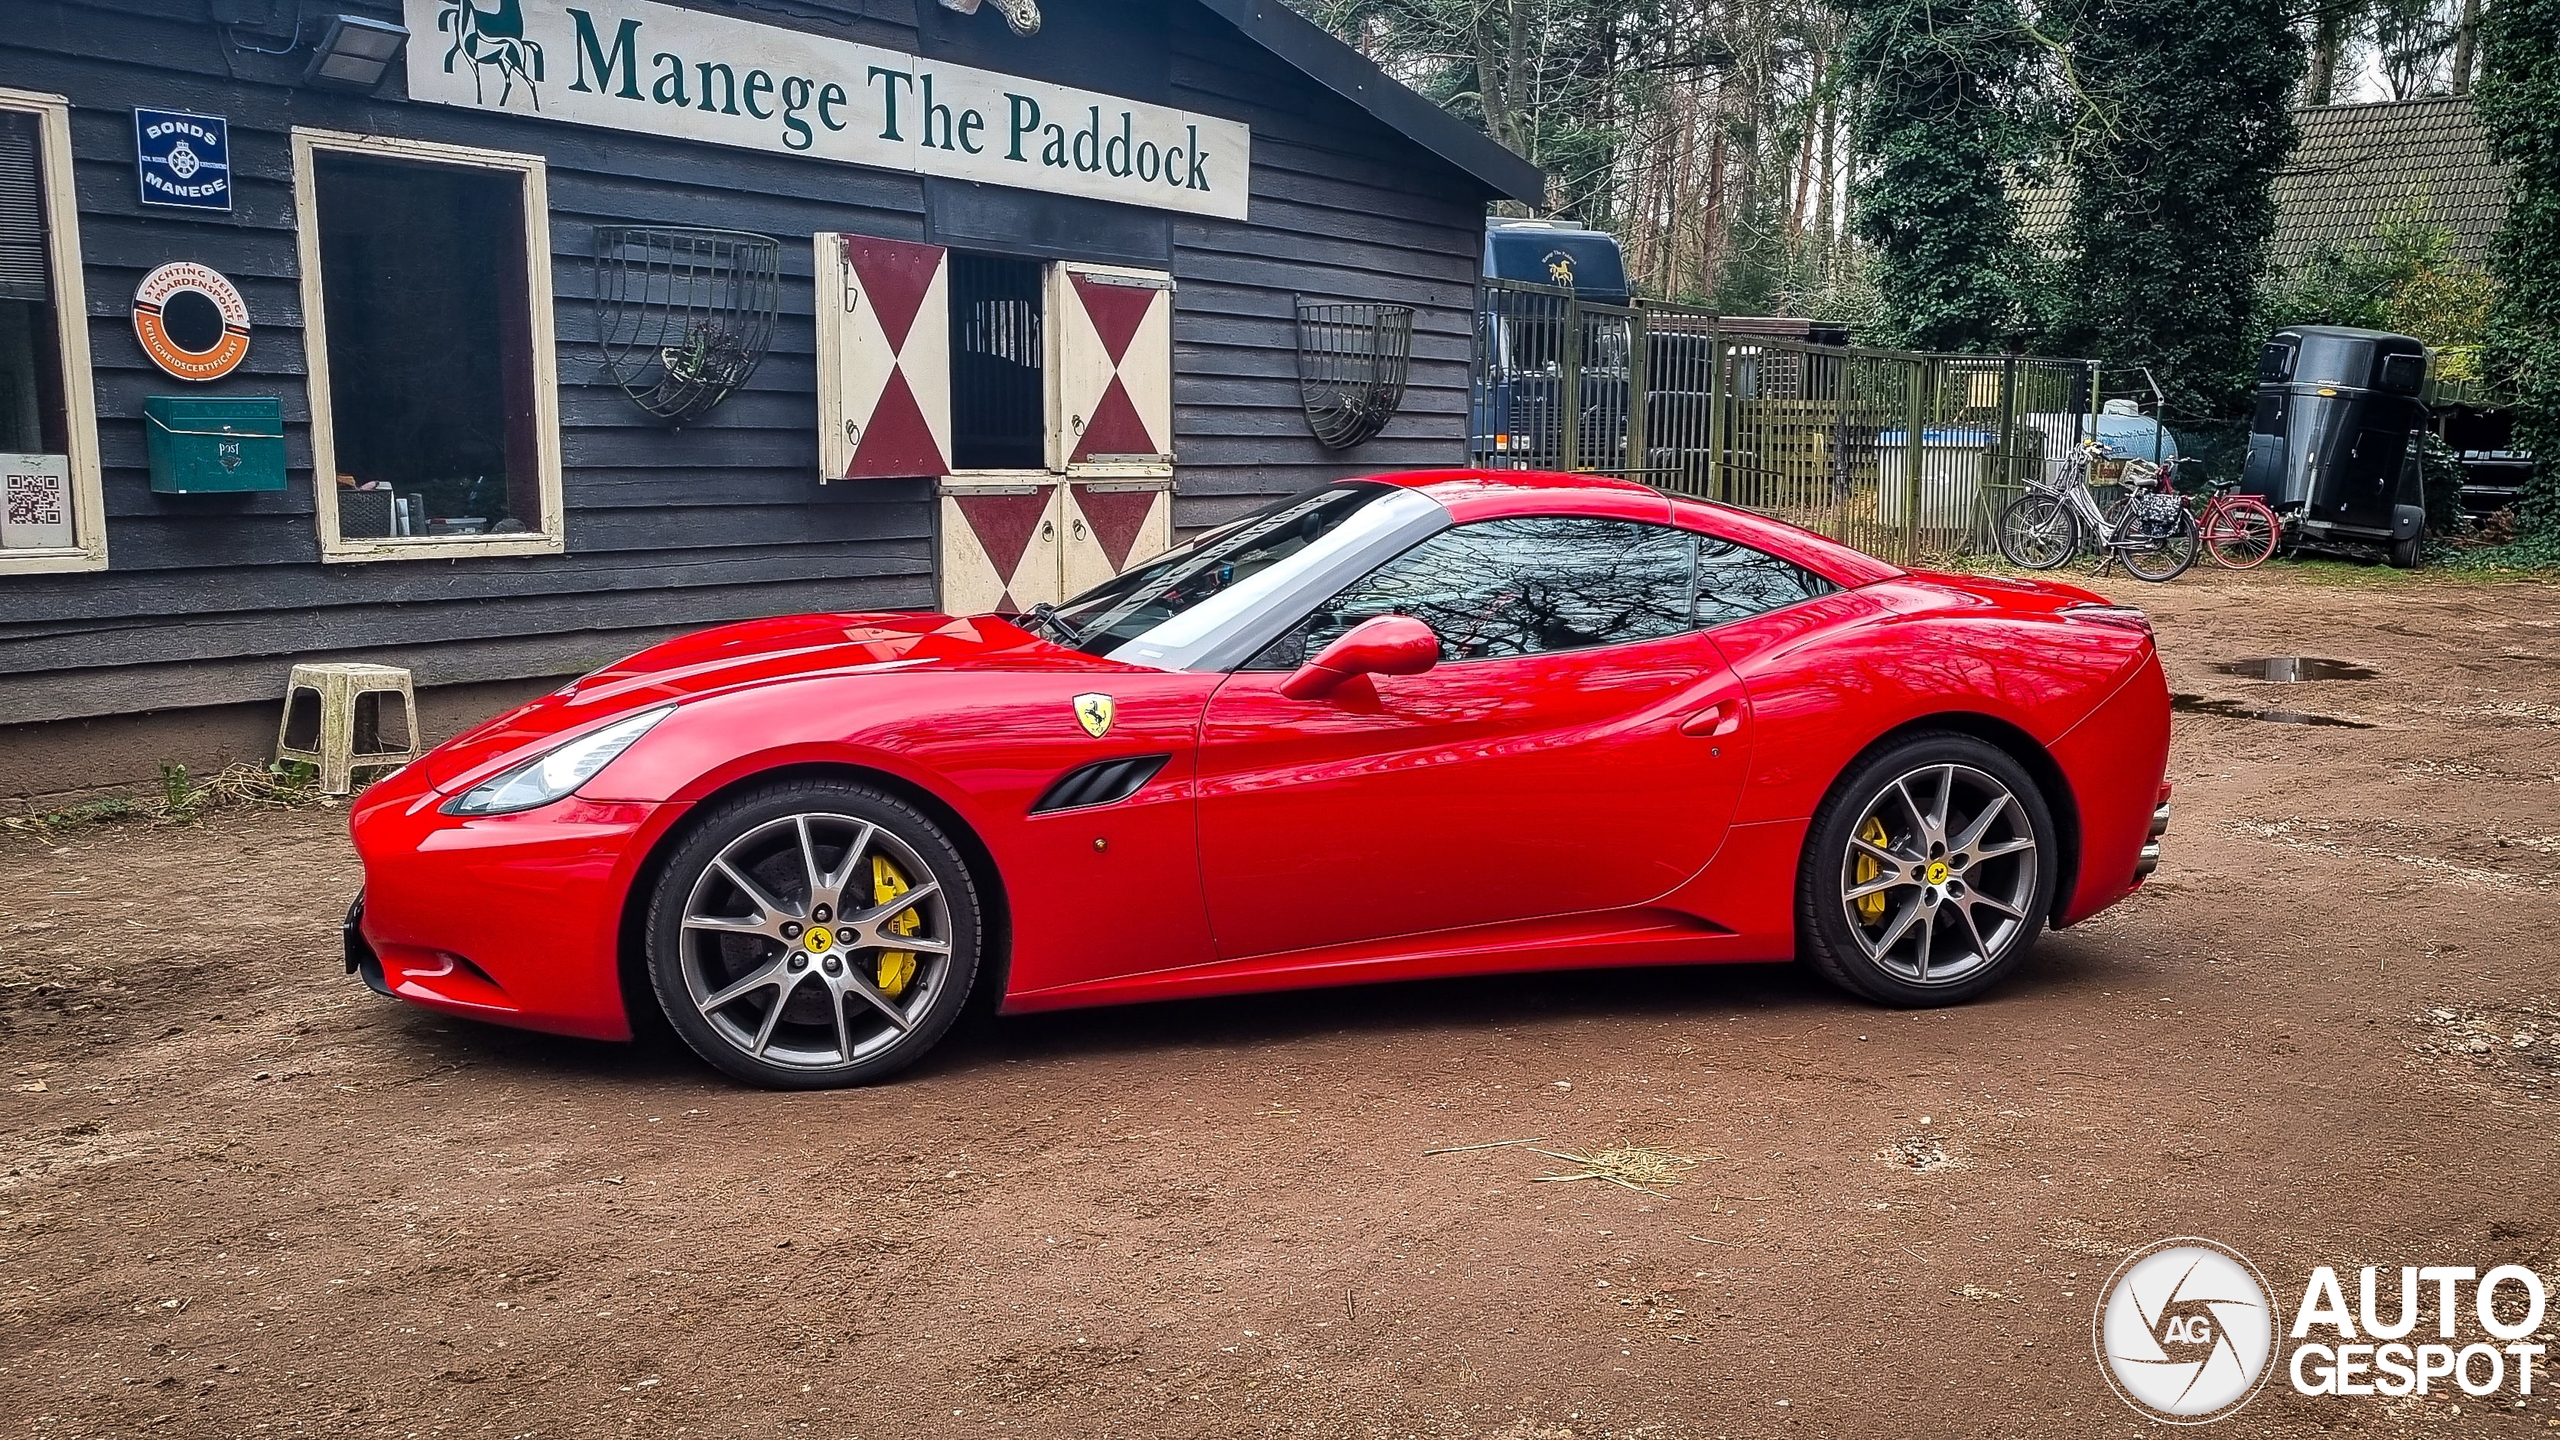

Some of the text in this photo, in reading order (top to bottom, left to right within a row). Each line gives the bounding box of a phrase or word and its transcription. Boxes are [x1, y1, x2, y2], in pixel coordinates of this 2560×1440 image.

[566, 7, 1211, 192] Manege The Paddock
[147, 122, 217, 146] BONDS
[145, 172, 227, 197] MANEGE
[144, 267, 245, 321] STICHTING VEILIGE
[155, 278, 235, 321] PAARDENSPORT
[144, 319, 238, 372] VEILIGHEIDSCERTIFICAAT
